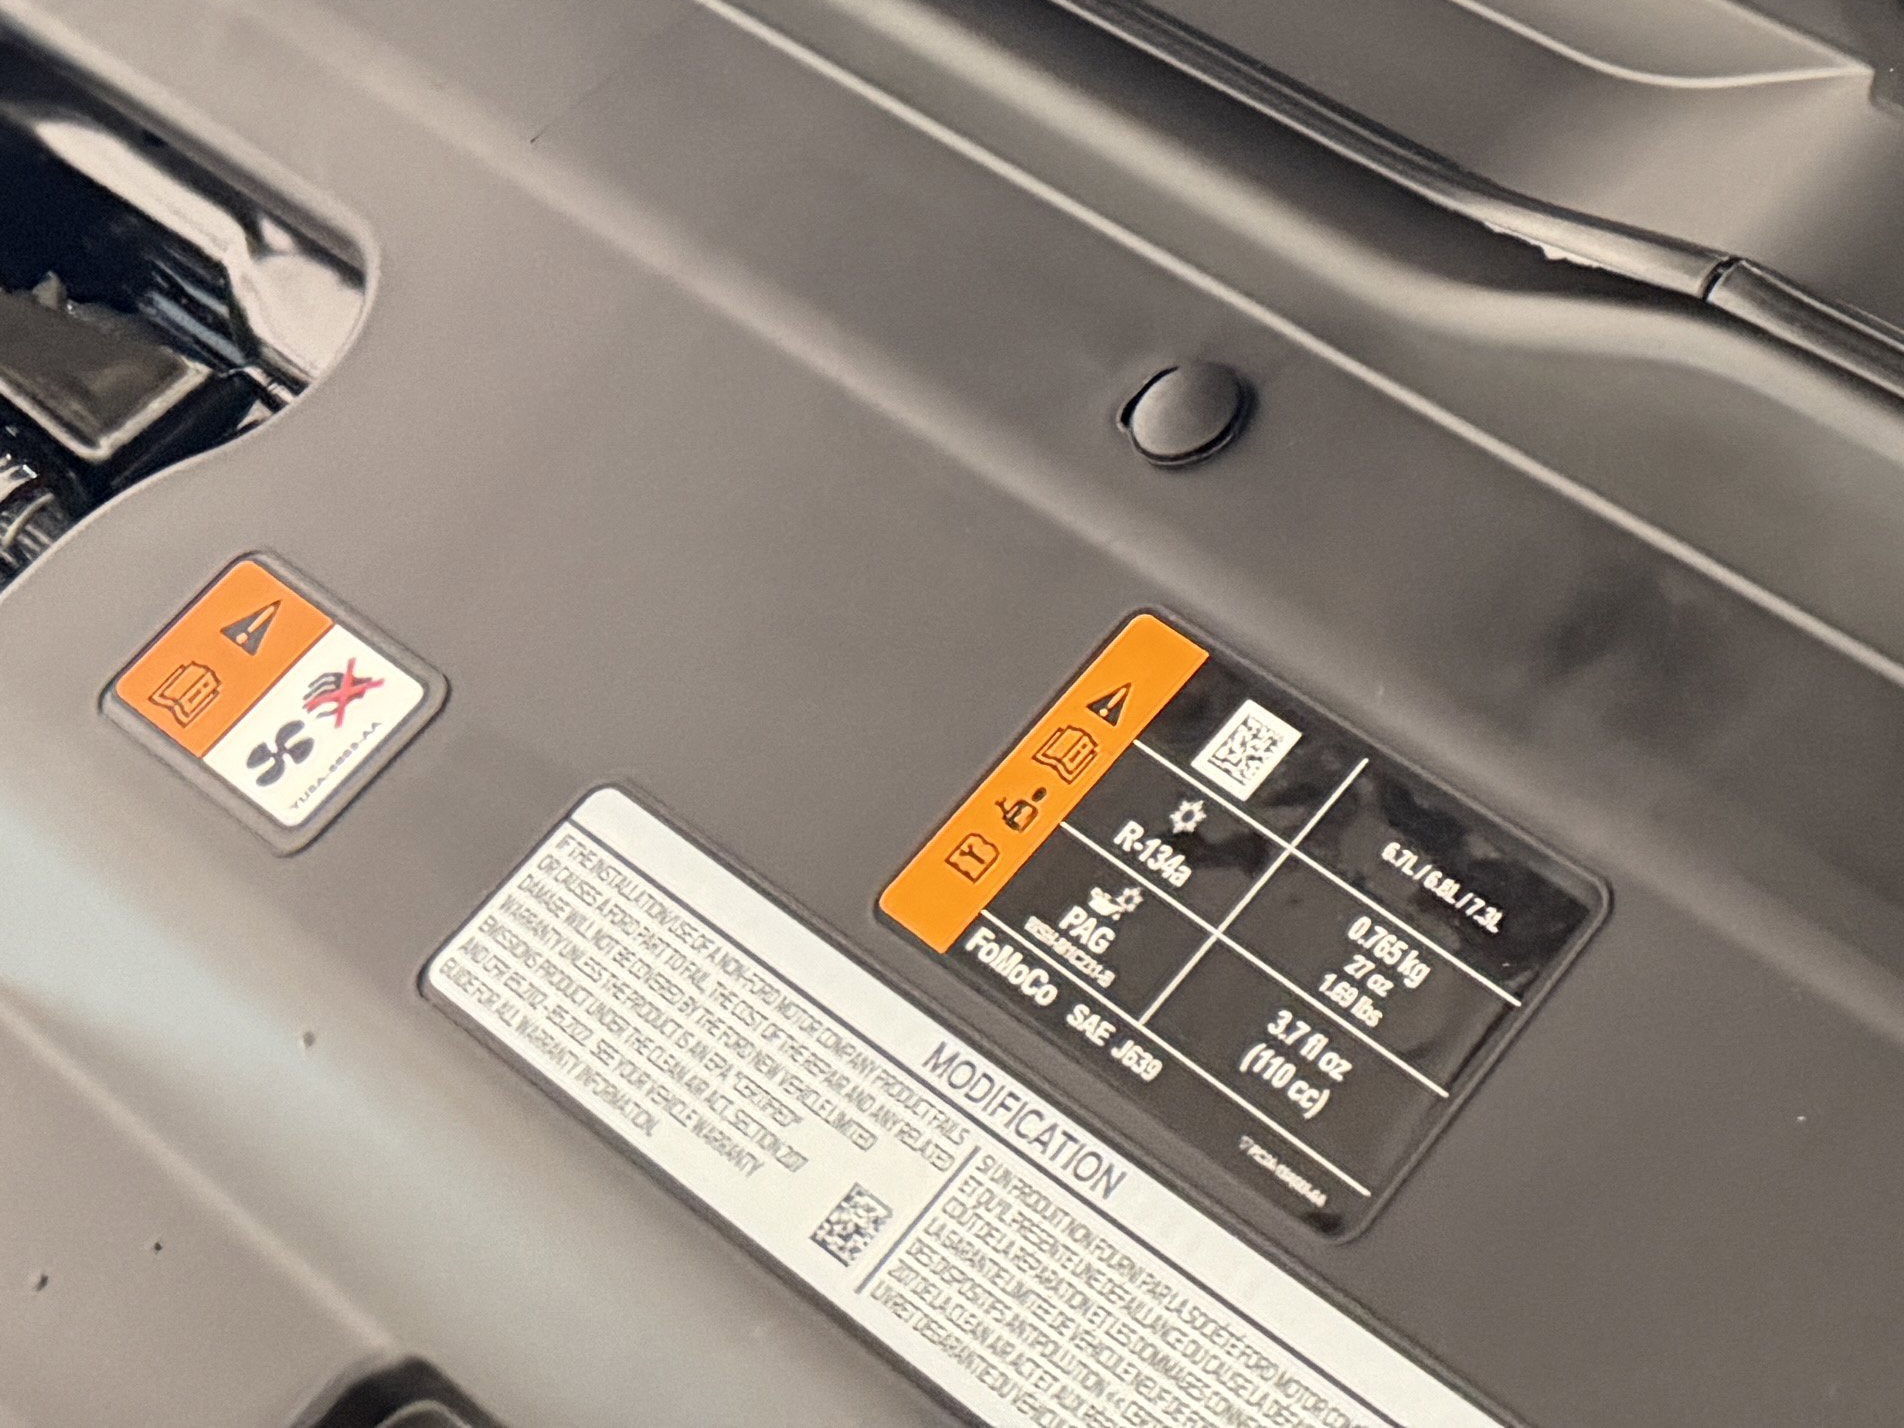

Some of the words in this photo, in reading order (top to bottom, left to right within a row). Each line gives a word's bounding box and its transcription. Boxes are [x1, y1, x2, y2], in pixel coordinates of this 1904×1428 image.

[1109, 818, 1200, 889] R-134a
[1055, 903, 1119, 957] PAG
[1342, 913, 1412, 969] 0.765
[1391, 947, 1437, 990] kg
[960, 926, 1066, 1010] FoMoCo
[1062, 1001, 1117, 1048] SAE
[1106, 1034, 1167, 1085] J639
[1314, 971, 1364, 1012] 1.69
[1352, 997, 1388, 1029] lbs
[1341, 952, 1375, 982] 27
[1364, 970, 1395, 998] oz
[1235, 1040, 1299, 1097] (110
[1279, 1072, 1333, 1123] cc)
[1262, 1006, 1311, 1050] 3.7
[1295, 1028, 1330, 1063] fl
[1313, 1046, 1355, 1084] oz
[921, 1040, 1129, 1202] MODIFICATION
